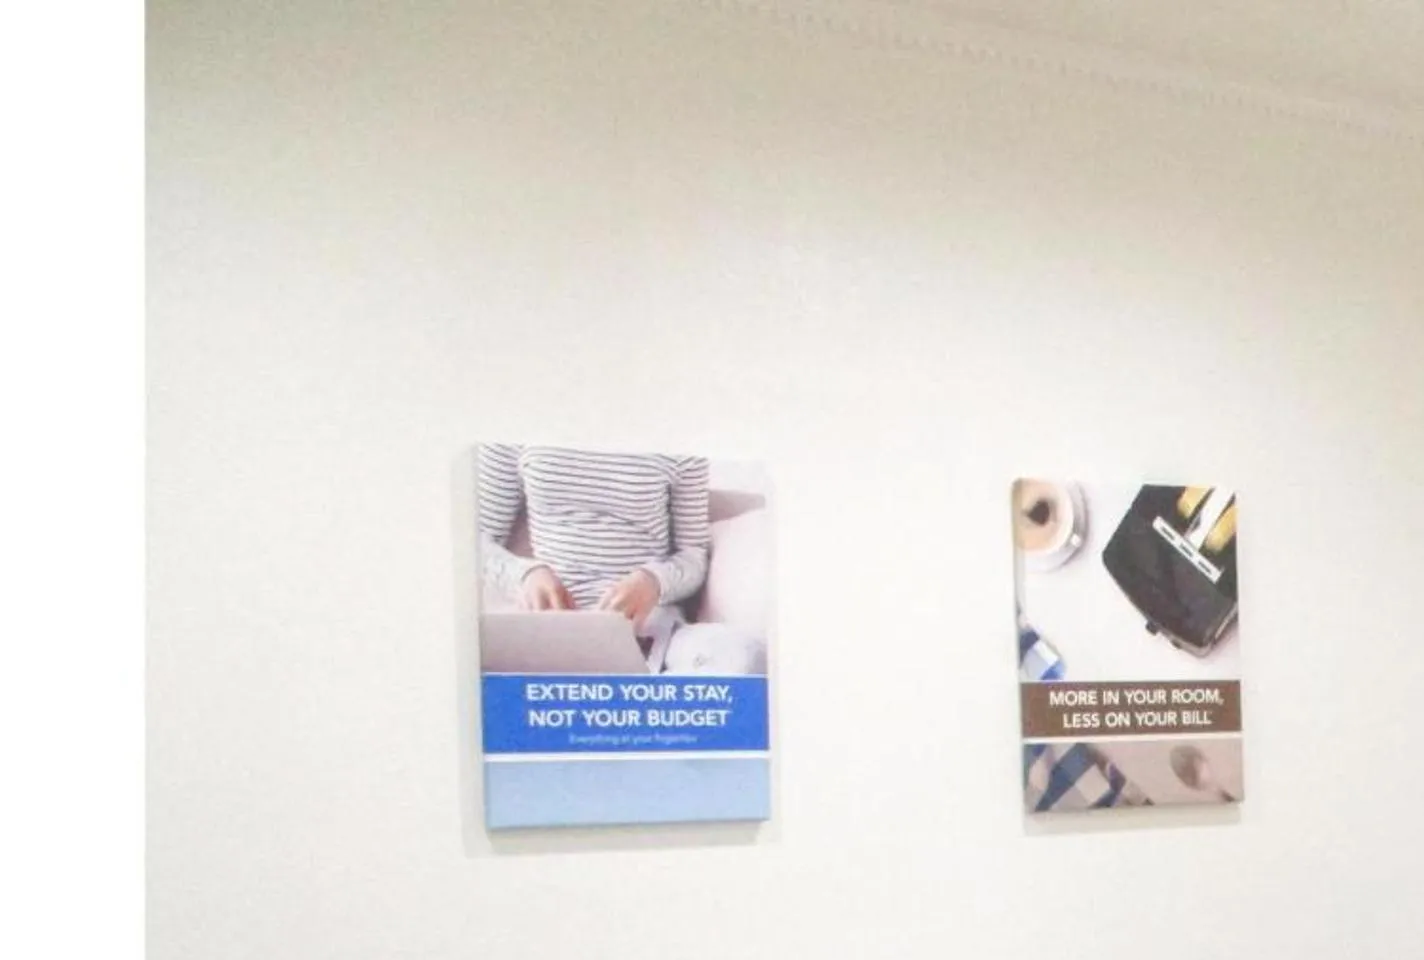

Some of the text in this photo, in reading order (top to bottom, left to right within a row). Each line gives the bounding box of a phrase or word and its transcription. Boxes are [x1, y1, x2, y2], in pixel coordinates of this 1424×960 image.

[526, 684, 733, 703] EXTEND YOUR STAY,
[1050, 688, 1224, 706] MORE IN YOUR ROOM,
[528, 709, 729, 727] NOT YOUR BUDGET
[1063, 711, 1210, 729] LESS ON YOUR BILL
